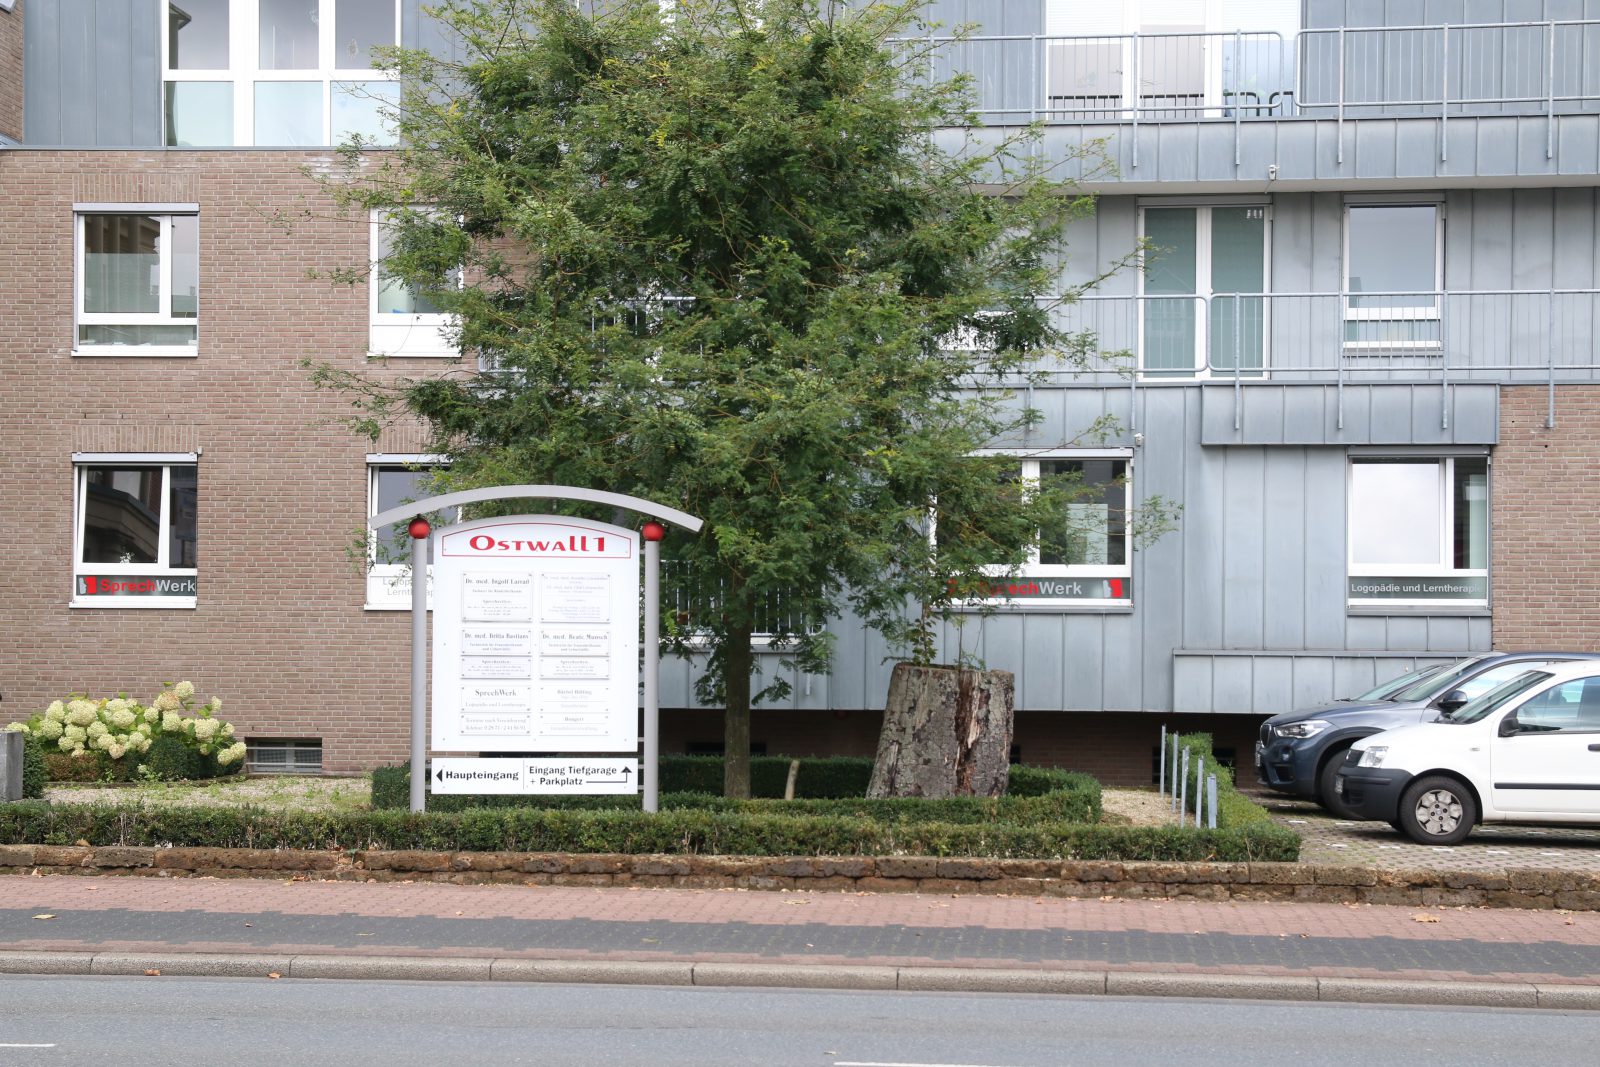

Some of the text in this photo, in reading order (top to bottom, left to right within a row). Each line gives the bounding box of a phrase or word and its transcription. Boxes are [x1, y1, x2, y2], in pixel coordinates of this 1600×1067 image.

[100, 578, 196, 595] SprechWerk
[1351, 583, 1400, 594] Logopädie
[1402, 583, 1420, 592] und
[474, 689, 517, 698] SprechWerk
[445, 770, 519, 781] Haupteingang
[529, 766, 617, 776] Eingang Tiefgarage
[539, 777, 583, 787] Parkplatz
